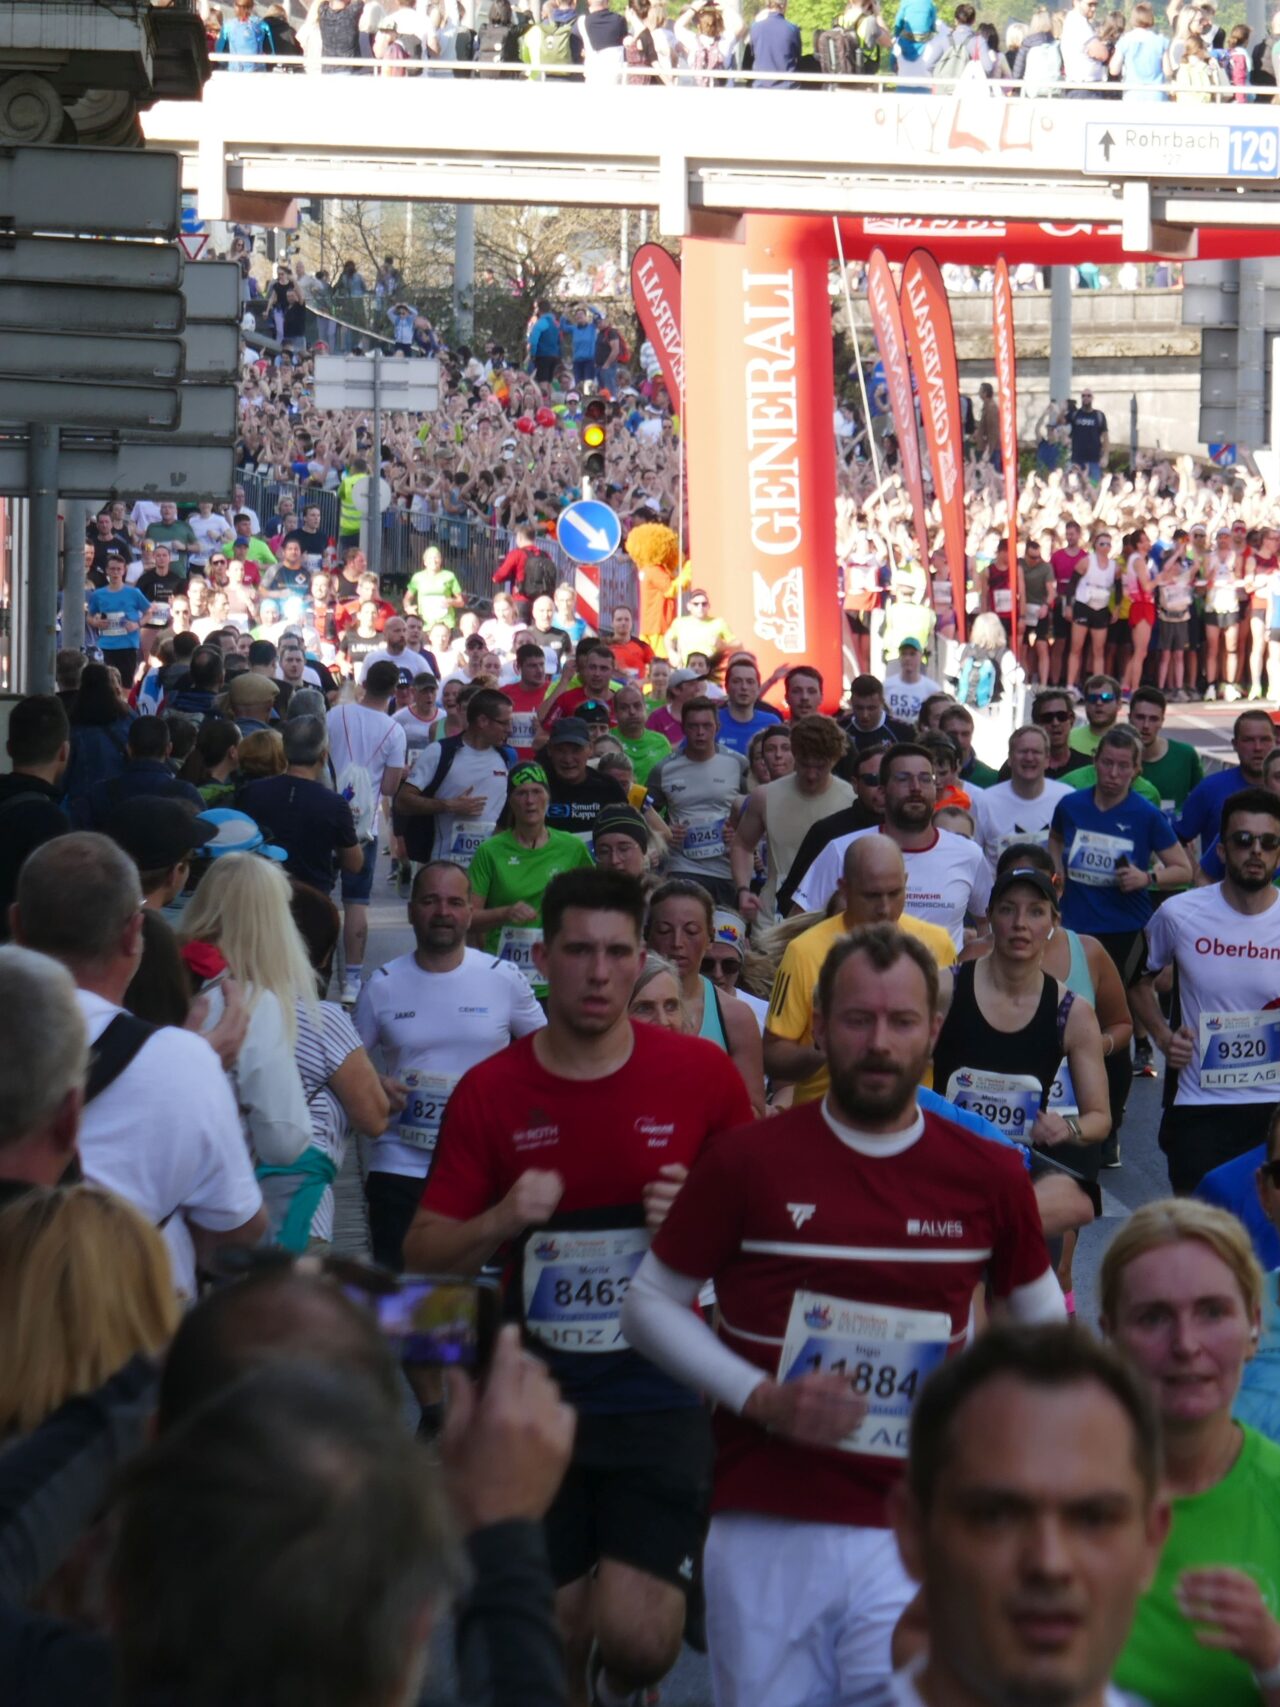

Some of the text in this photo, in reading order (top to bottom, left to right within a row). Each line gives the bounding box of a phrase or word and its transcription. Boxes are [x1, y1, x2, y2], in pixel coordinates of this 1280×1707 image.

[1125, 129, 1220, 151] Rohrbach
[1229, 130, 1278, 172] 129
[742, 268, 802, 555] GENERALI
[571, 802, 600, 811] Smurfit
[571, 811, 596, 821] Kappa
[459, 837, 485, 850] 109
[689, 829, 720, 843] 9245
[394, 1010, 416, 1020] JAKO
[1218, 1039, 1266, 1060] 9320
[1206, 1069, 1277, 1084] LINZ AG
[921, 1220, 963, 1238] ALVES
